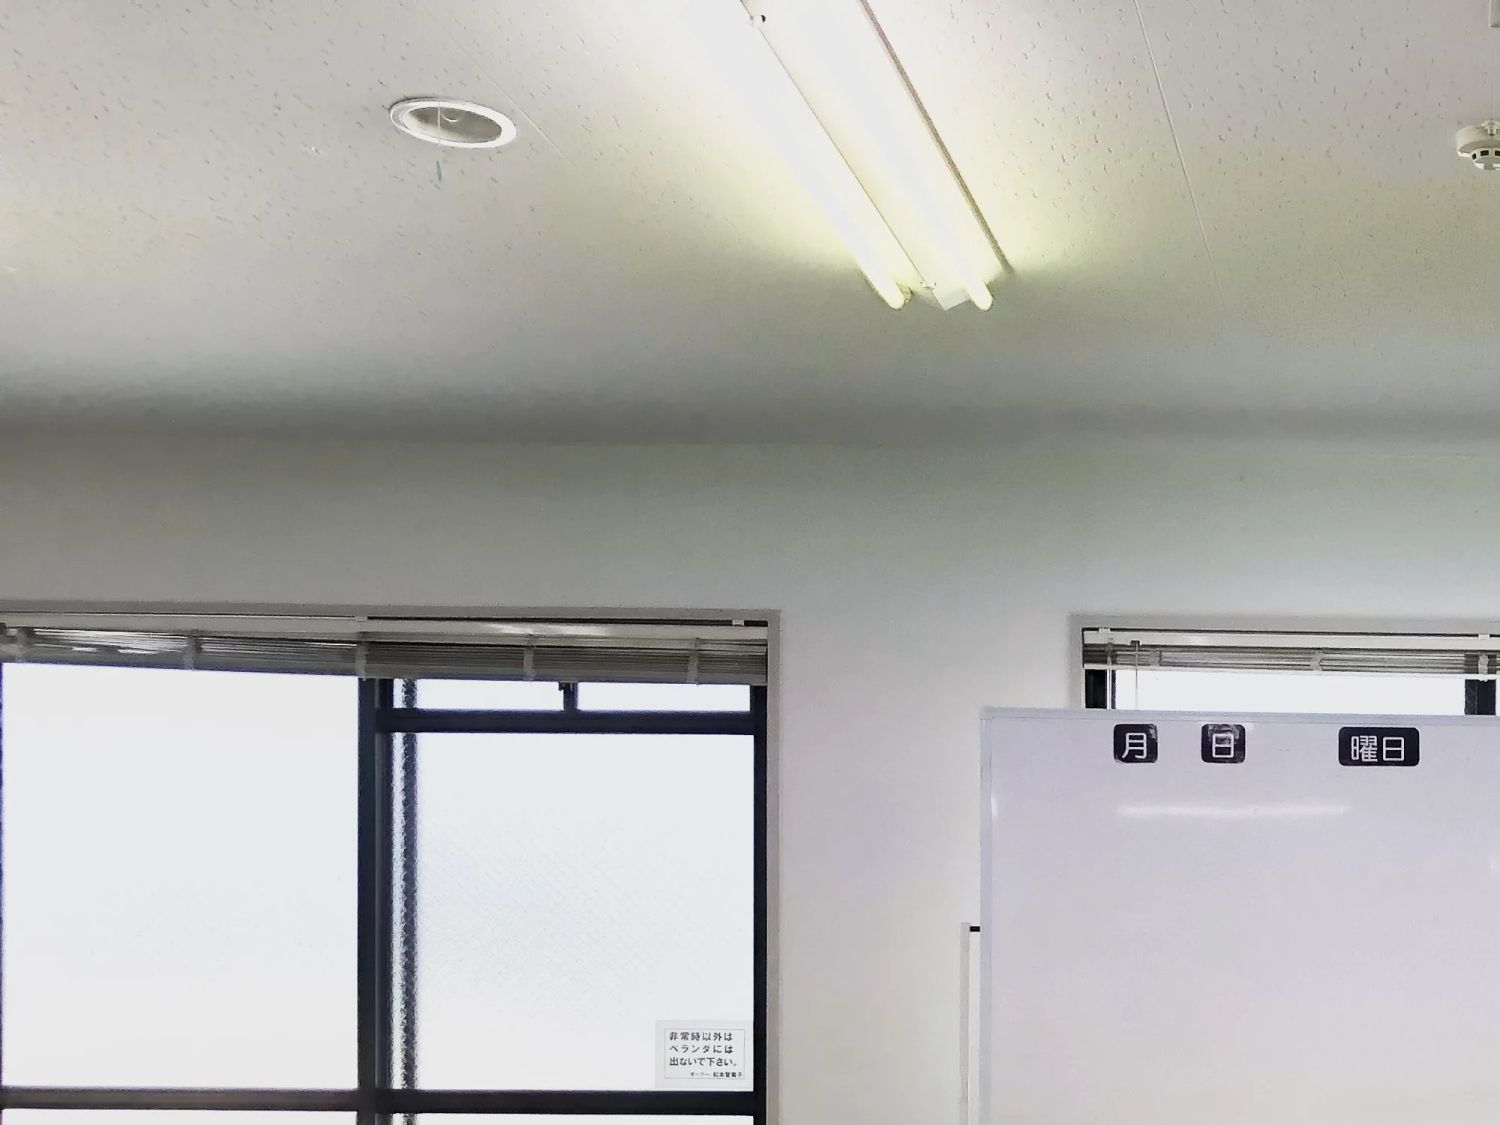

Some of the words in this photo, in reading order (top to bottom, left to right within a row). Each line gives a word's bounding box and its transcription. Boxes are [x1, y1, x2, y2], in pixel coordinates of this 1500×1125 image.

[1121, 732, 1147, 759] 月
[1212, 733, 1235, 759] 日
[1351, 735, 1405, 762] 曜日
[669, 1031, 733, 1042] 非常時以外は
[669, 1044, 734, 1054] ベランダには
[669, 1056, 737, 1067] 出ないで下さい。
